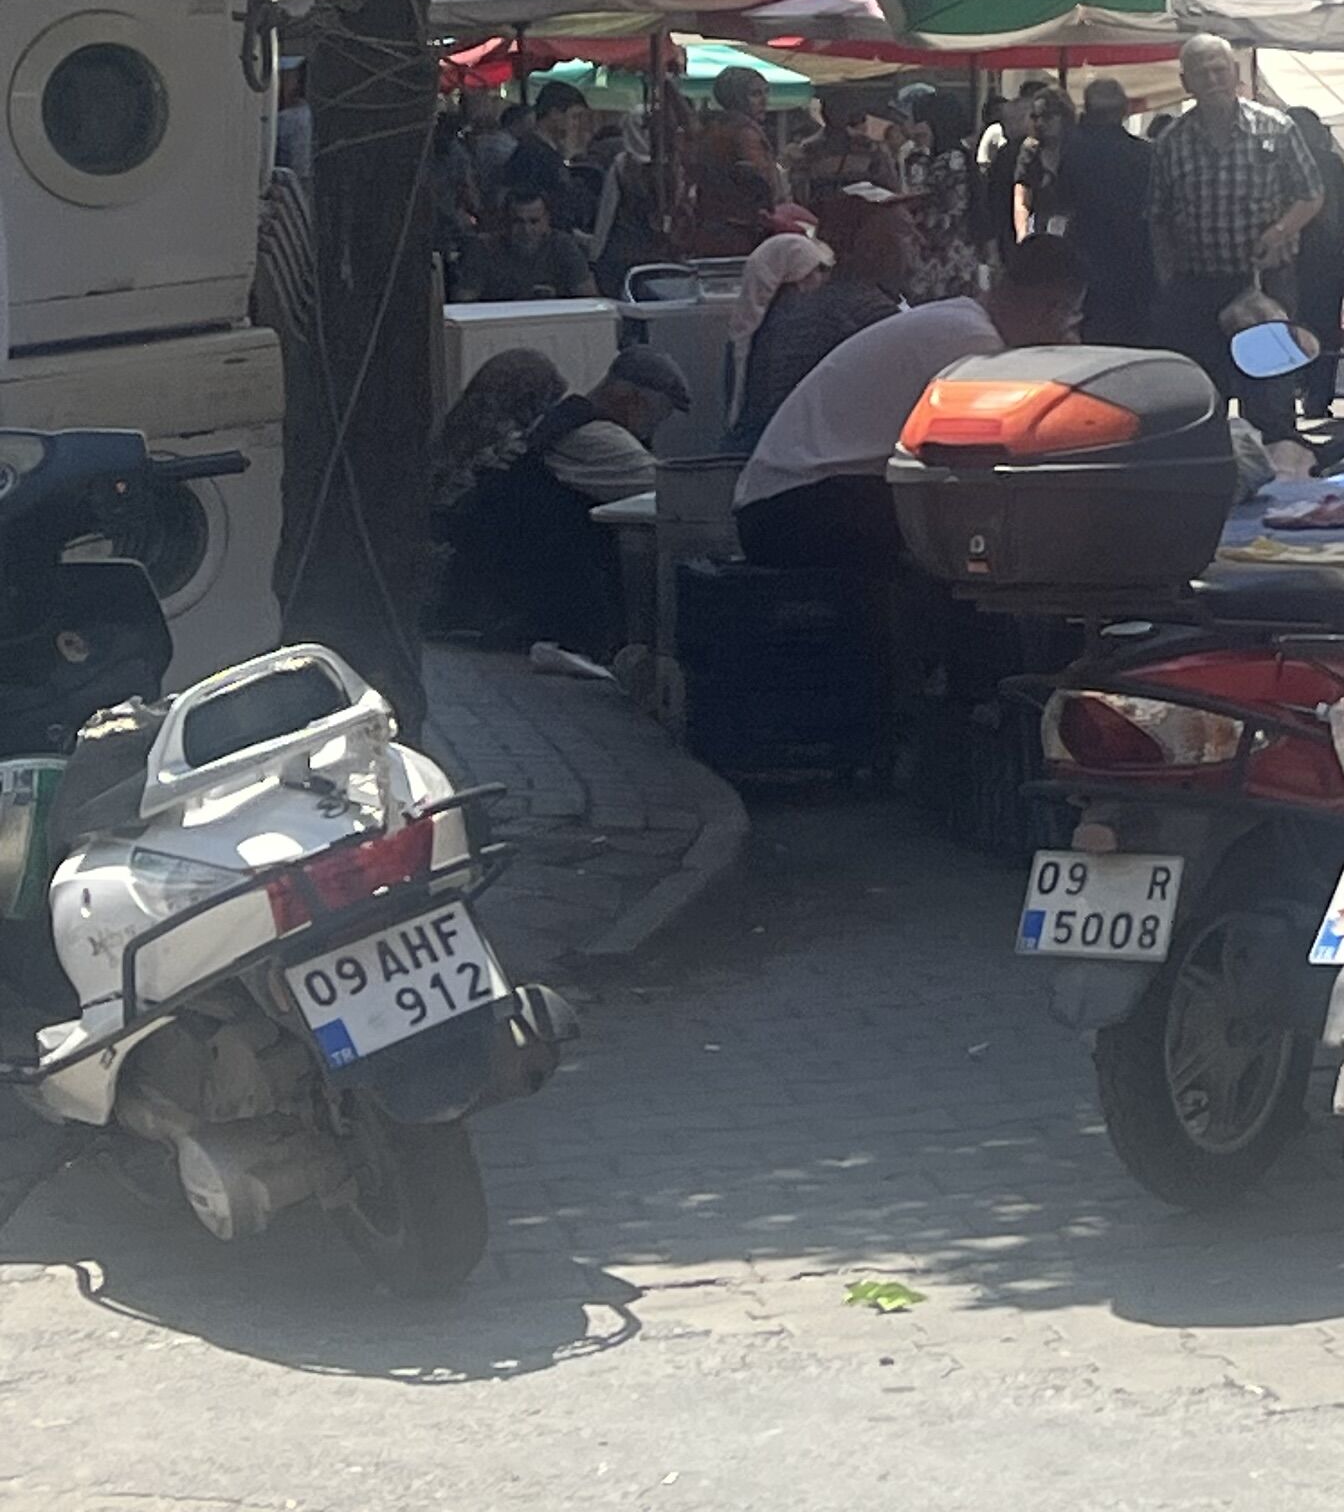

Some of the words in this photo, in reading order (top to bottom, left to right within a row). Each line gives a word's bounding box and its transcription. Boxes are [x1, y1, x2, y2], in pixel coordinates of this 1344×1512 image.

[1037, 862, 1088, 895] 09
[1147, 866, 1171, 900] R
[1054, 910, 1160, 949] 5008
[304, 956, 368, 1007] 09
[376, 912, 458, 982] AHF
[395, 962, 491, 1026] 912
[330, 1046, 356, 1067] TR
